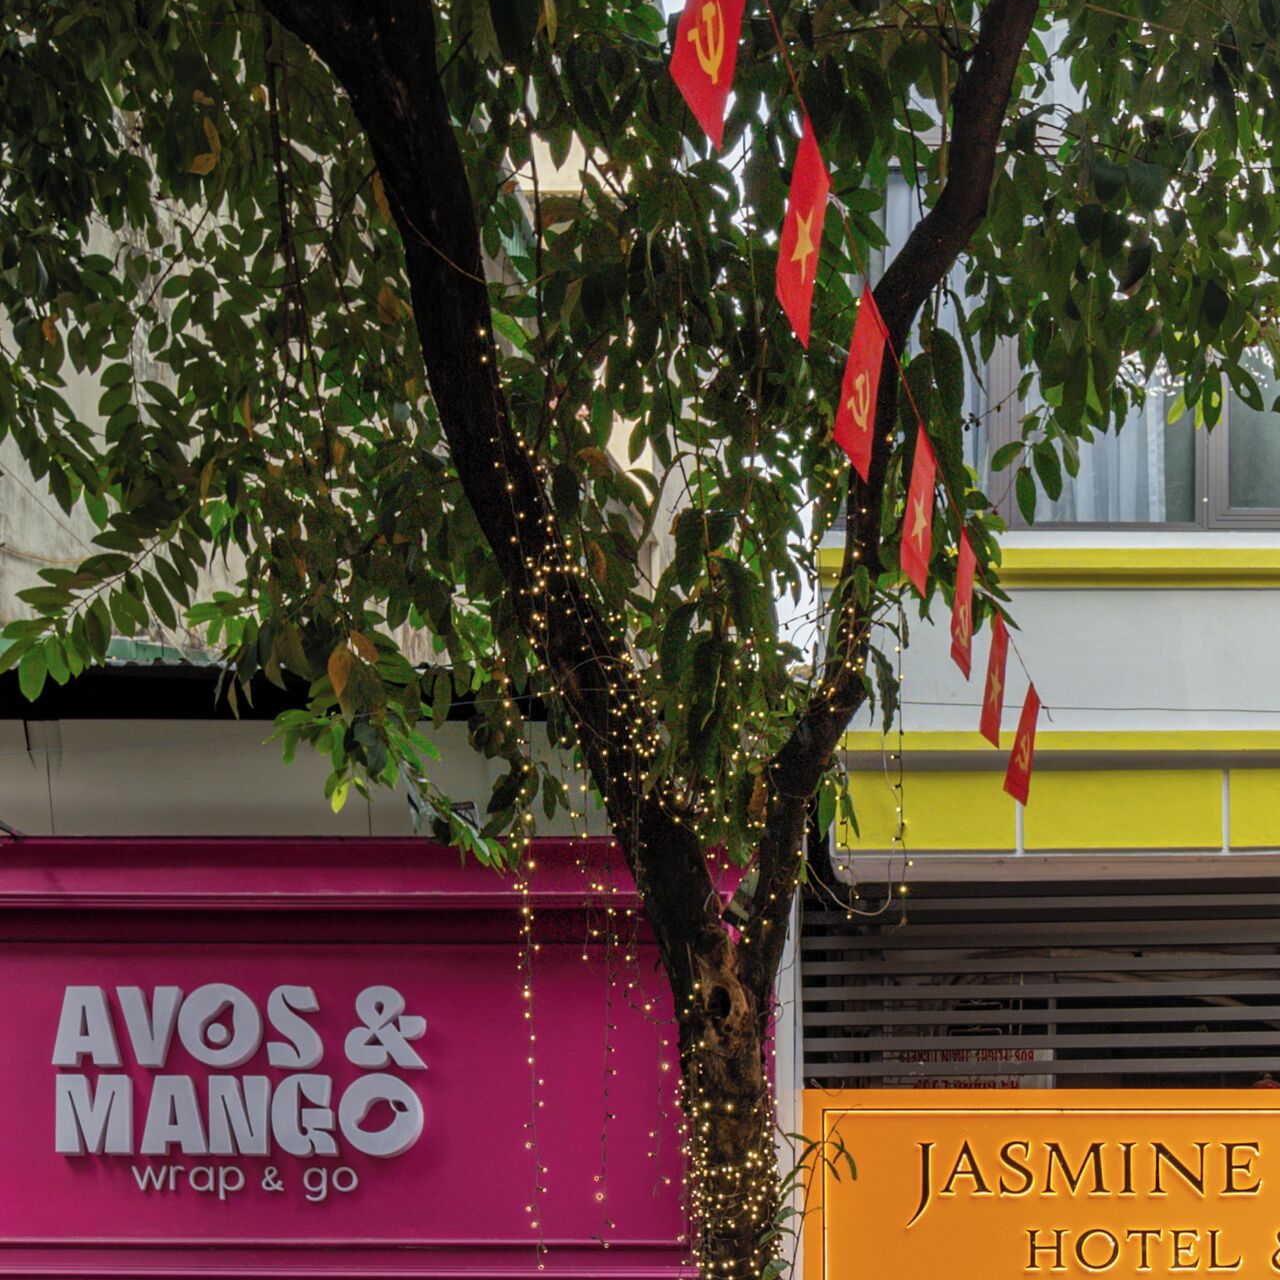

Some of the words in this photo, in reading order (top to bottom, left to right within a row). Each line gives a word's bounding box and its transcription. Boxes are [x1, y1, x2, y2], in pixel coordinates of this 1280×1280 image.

[52, 983, 324, 1069] AVOS
[344, 984, 429, 1070] &
[55, 1073, 425, 1158] MANGO
[131, 1165, 245, 1200] wrap
[261, 1166, 284, 1192] &
[303, 1166, 359, 1202] go
[906, 1140, 1264, 1228] JASMINE
[1024, 1228, 1243, 1272] HOTEL
